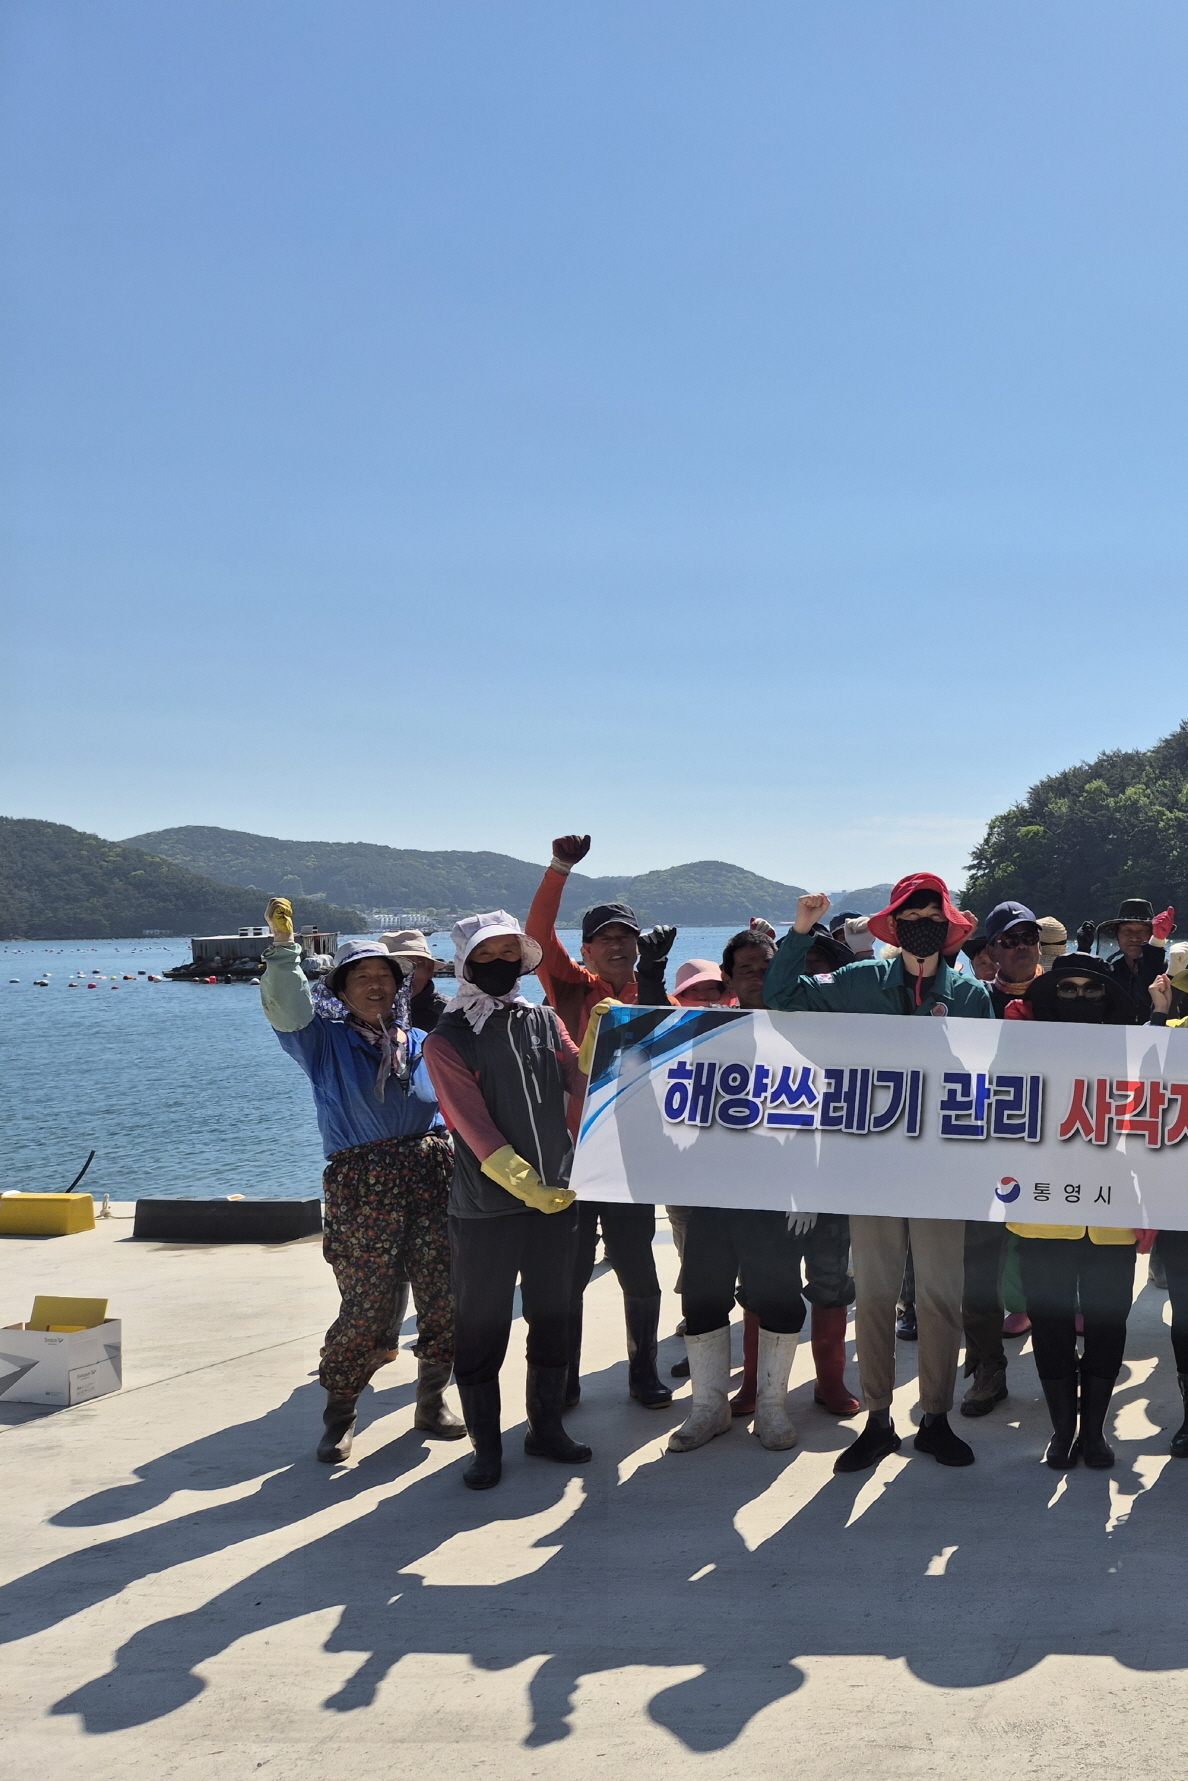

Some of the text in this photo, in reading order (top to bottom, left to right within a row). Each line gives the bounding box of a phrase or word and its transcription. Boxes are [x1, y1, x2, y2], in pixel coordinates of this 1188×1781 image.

[663, 1060, 921, 1135] 해양쓰레기
[939, 1071, 1041, 1140] 관리
[1032, 1182, 1111, 1205] 통영시
